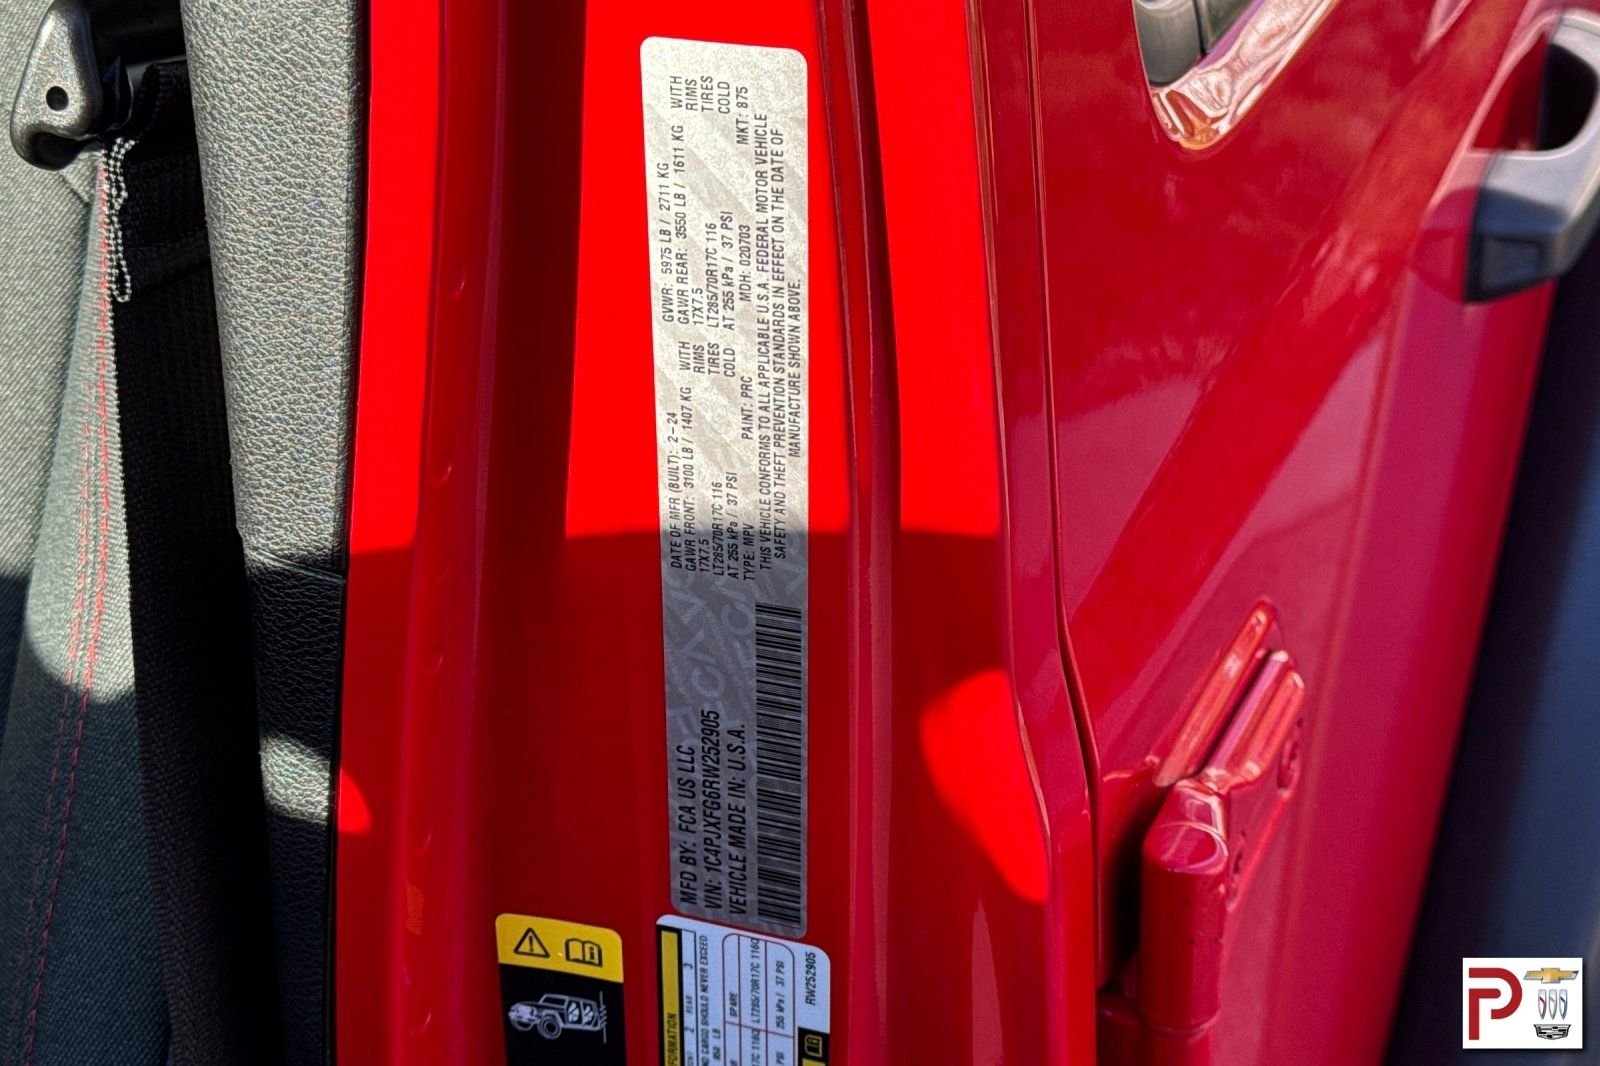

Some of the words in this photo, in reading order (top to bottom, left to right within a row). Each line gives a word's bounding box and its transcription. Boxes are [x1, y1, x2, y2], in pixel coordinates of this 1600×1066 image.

[670, 76, 682, 108] WITH
[686, 79, 697, 110] RIMS
[701, 76, 713, 112] TIRES
[718, 81, 730, 114] COLD
[736, 86, 748, 108] 875
[672, 125, 683, 141] KG
[737, 114, 748, 144] MKT:
[755, 114, 768, 165] VEHICLE
[770, 129, 783, 145] OF
[657, 163, 669, 178] KG
[674, 148, 684, 173] 1611
[771, 151, 783, 182] DATE
[658, 185, 670, 211] 2711
[674, 193, 685, 206] LB
[756, 171, 768, 213] MOTOR
[771, 187, 784, 211] THE
[675, 212, 686, 239] 3550
[706, 223, 716, 242] 116
[721, 211, 732, 230] PSI
[772, 216, 784, 233] ON
[660, 229, 670, 243] LB
[722, 236, 733, 249] 37
[739, 224, 751, 266] 020703
[756, 219, 769, 272] FEDERAL
[661, 247, 672, 274] 5975
[677, 248, 688, 284] REAR:
[772, 238, 784, 281] EFFECT
[706, 248, 719, 328] LT285/70R17C
[722, 267, 733, 287] kPa
[740, 270, 751, 301] MDH:
[662, 283, 674, 322] GVWR:
[692, 288, 703, 325] 17X7.5
[723, 291, 734, 311] 255
[757, 279, 769, 313] U.S.A.
[772, 286, 784, 298] IN
[788, 279, 801, 321] ABOVE.
[678, 290, 689, 324] GAWR
[723, 315, 734, 330] AT
[757, 319, 770, 387] APPLICABLE
[772, 304, 785, 373] STANDARDS
[788, 325, 800, 368] SHOWN
[680, 341, 690, 370] WITH
[694, 345, 705, 373] RIMS
[708, 343, 719, 375] TIRES
[724, 348, 734, 377] COLD
[681, 387, 691, 401] KG
[741, 376, 753, 398] PRC
[758, 391, 770, 411] ALL
[682, 406, 692, 430] 1407
[742, 403, 753, 440] PAINT:
[758, 415, 770, 429] TO
[773, 378, 785, 448] PREVENTION
[789, 372, 801, 457] MANUFACTURE
[683, 447, 693, 459] LB
[758, 434, 771, 495] CONFORMS
[667, 451, 681, 493] (BUILT):
[683, 464, 694, 488] 3100
[726, 472, 737, 489] PSI
[773, 453, 785, 487] THEFT
[711, 482, 721, 500] 116
[726, 492, 737, 506] 37
[774, 493, 785, 515] AND
[668, 497, 680, 519] MFR
[683, 497, 695, 535] FRONT:
[759, 499, 771, 542] VEHICLE
[669, 523, 680, 537] OF
[711, 503, 724, 575] LT285/70R17C
[727, 522, 737, 539] kPa
[743, 523, 754, 546] MPV
[774, 517, 786, 559] SAFETY
[670, 541, 681, 568] DATE
[685, 540, 695, 571] GAWR
[699, 539, 709, 573] 17X7.5
[728, 543, 738, 561] 255
[743, 550, 755, 581] TYPE:
[760, 547, 771, 569] THIS
[728, 565, 738, 579] AT
[677, 745, 695, 772] LLC
[727, 724, 745, 771] U.S.A.
[678, 776, 695, 799] US
[701, 710, 722, 873] 1C4PJXFG6RW252905
[728, 777, 745, 798] IN:
[679, 806, 696, 833] FCA
[728, 804, 746, 849] MADE
[679, 841, 696, 866] BY:
[680, 869, 697, 904] MFD
[705, 880, 722, 909] VIN:
[728, 855, 747, 914] VEHICLE
[699, 935, 708, 965] EXCEED
[700, 967, 708, 993] NEVER
[806, 952, 816, 1005] RW252905
[700, 996, 708, 1026] SHOULD
[701, 1029, 709, 1054] CARGO
